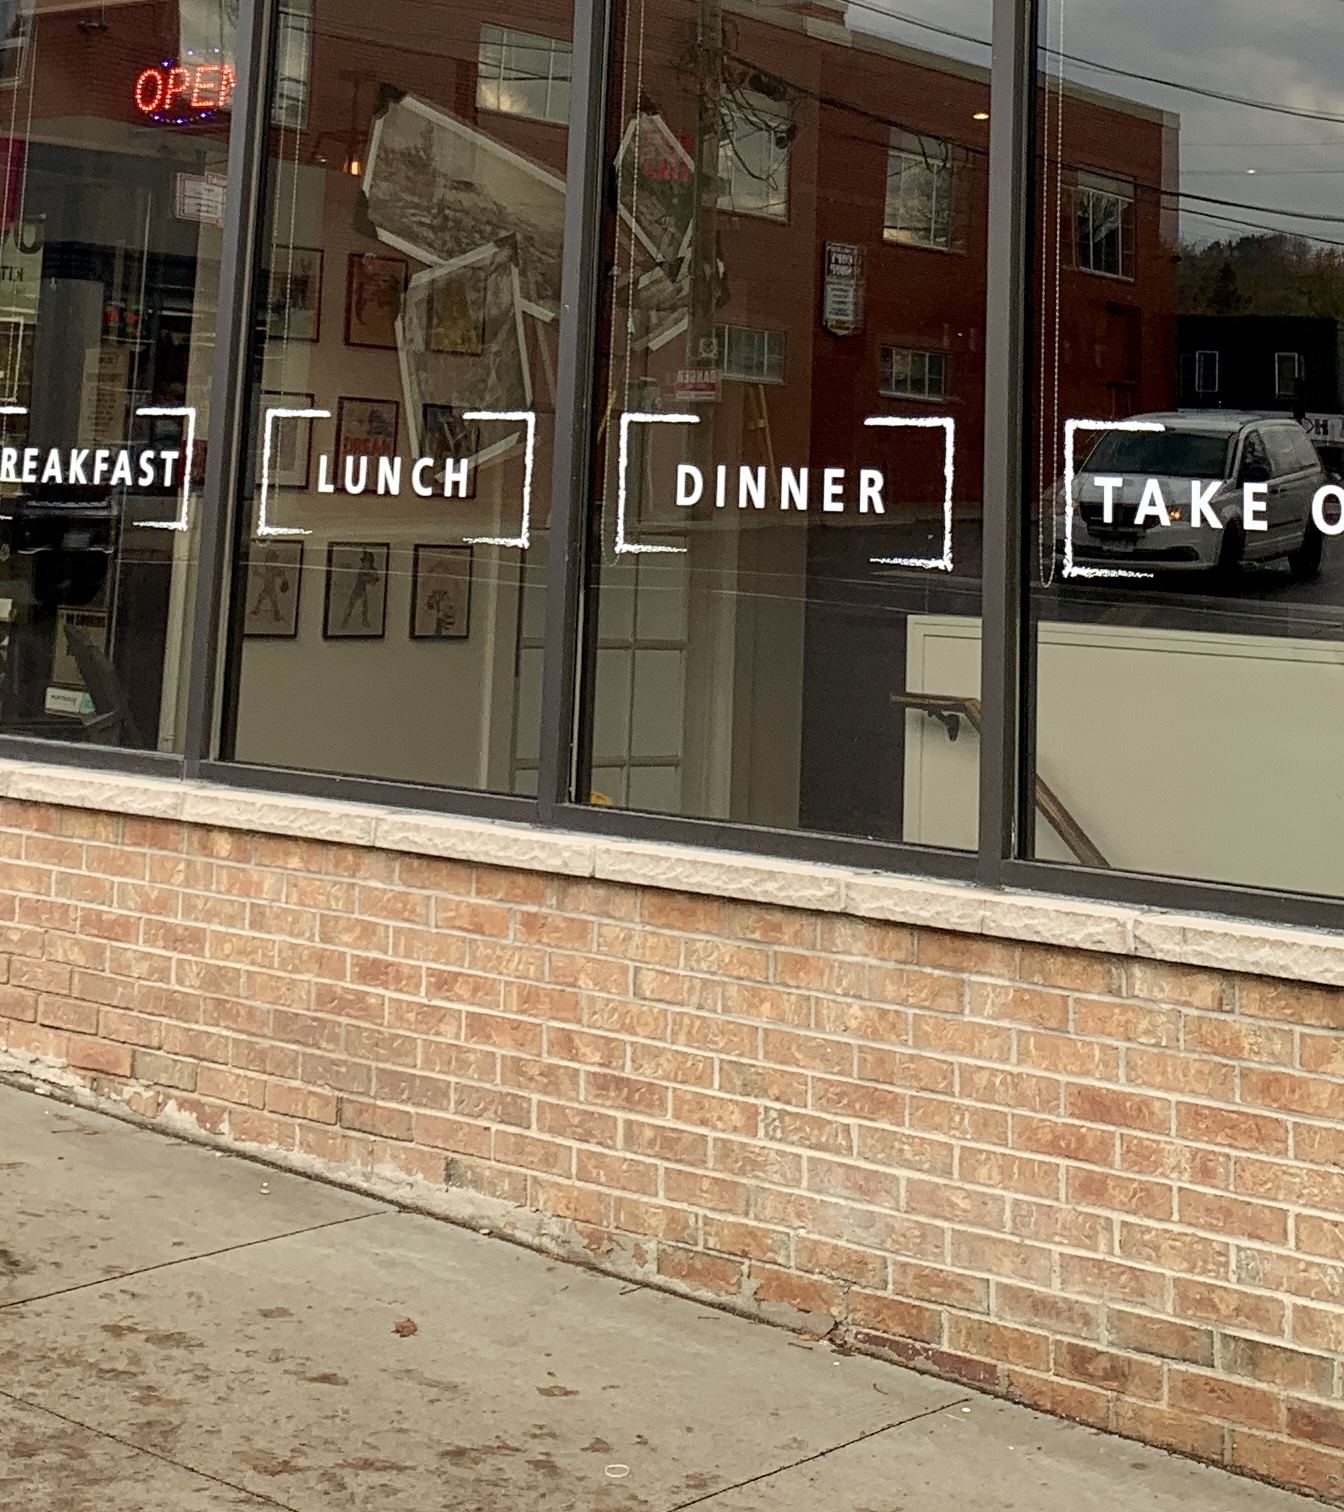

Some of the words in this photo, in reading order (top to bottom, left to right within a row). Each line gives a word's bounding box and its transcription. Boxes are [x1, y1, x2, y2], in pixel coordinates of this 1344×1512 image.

[317, 454, 469, 498] LUNCH
[675, 463, 886, 515] DINNER
[1092, 475, 1269, 532] TAKE
